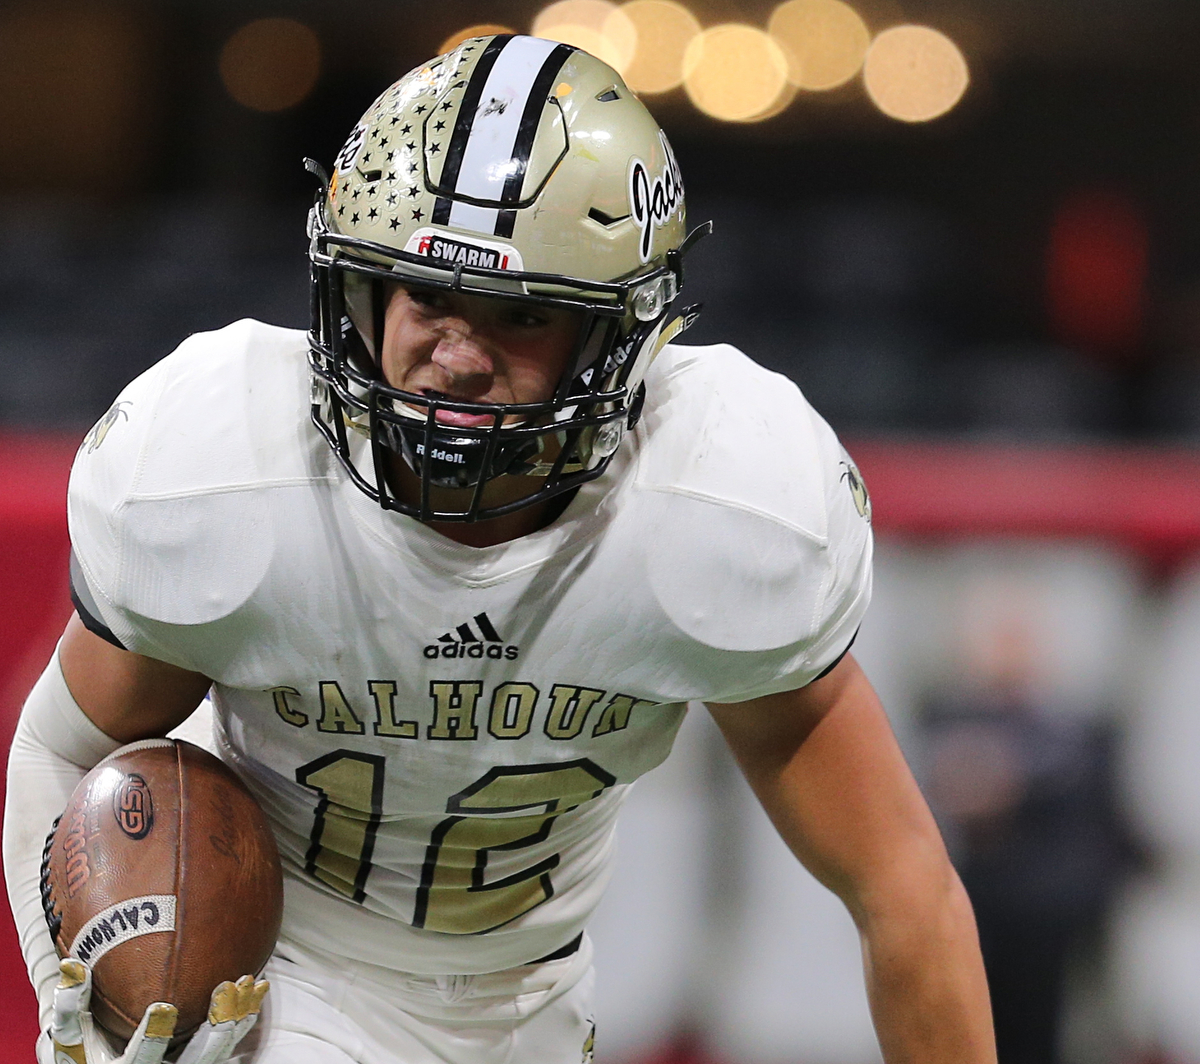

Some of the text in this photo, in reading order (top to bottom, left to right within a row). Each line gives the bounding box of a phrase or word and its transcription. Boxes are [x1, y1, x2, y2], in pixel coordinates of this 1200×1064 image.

[431, 240, 496, 269] SWARM
[416, 443, 464, 464] Rddell
[423, 641, 519, 660] adidas
[266, 680, 661, 741] CALHOUN
[295, 748, 617, 936] 12
[77, 902, 160, 964] CALHOUN
